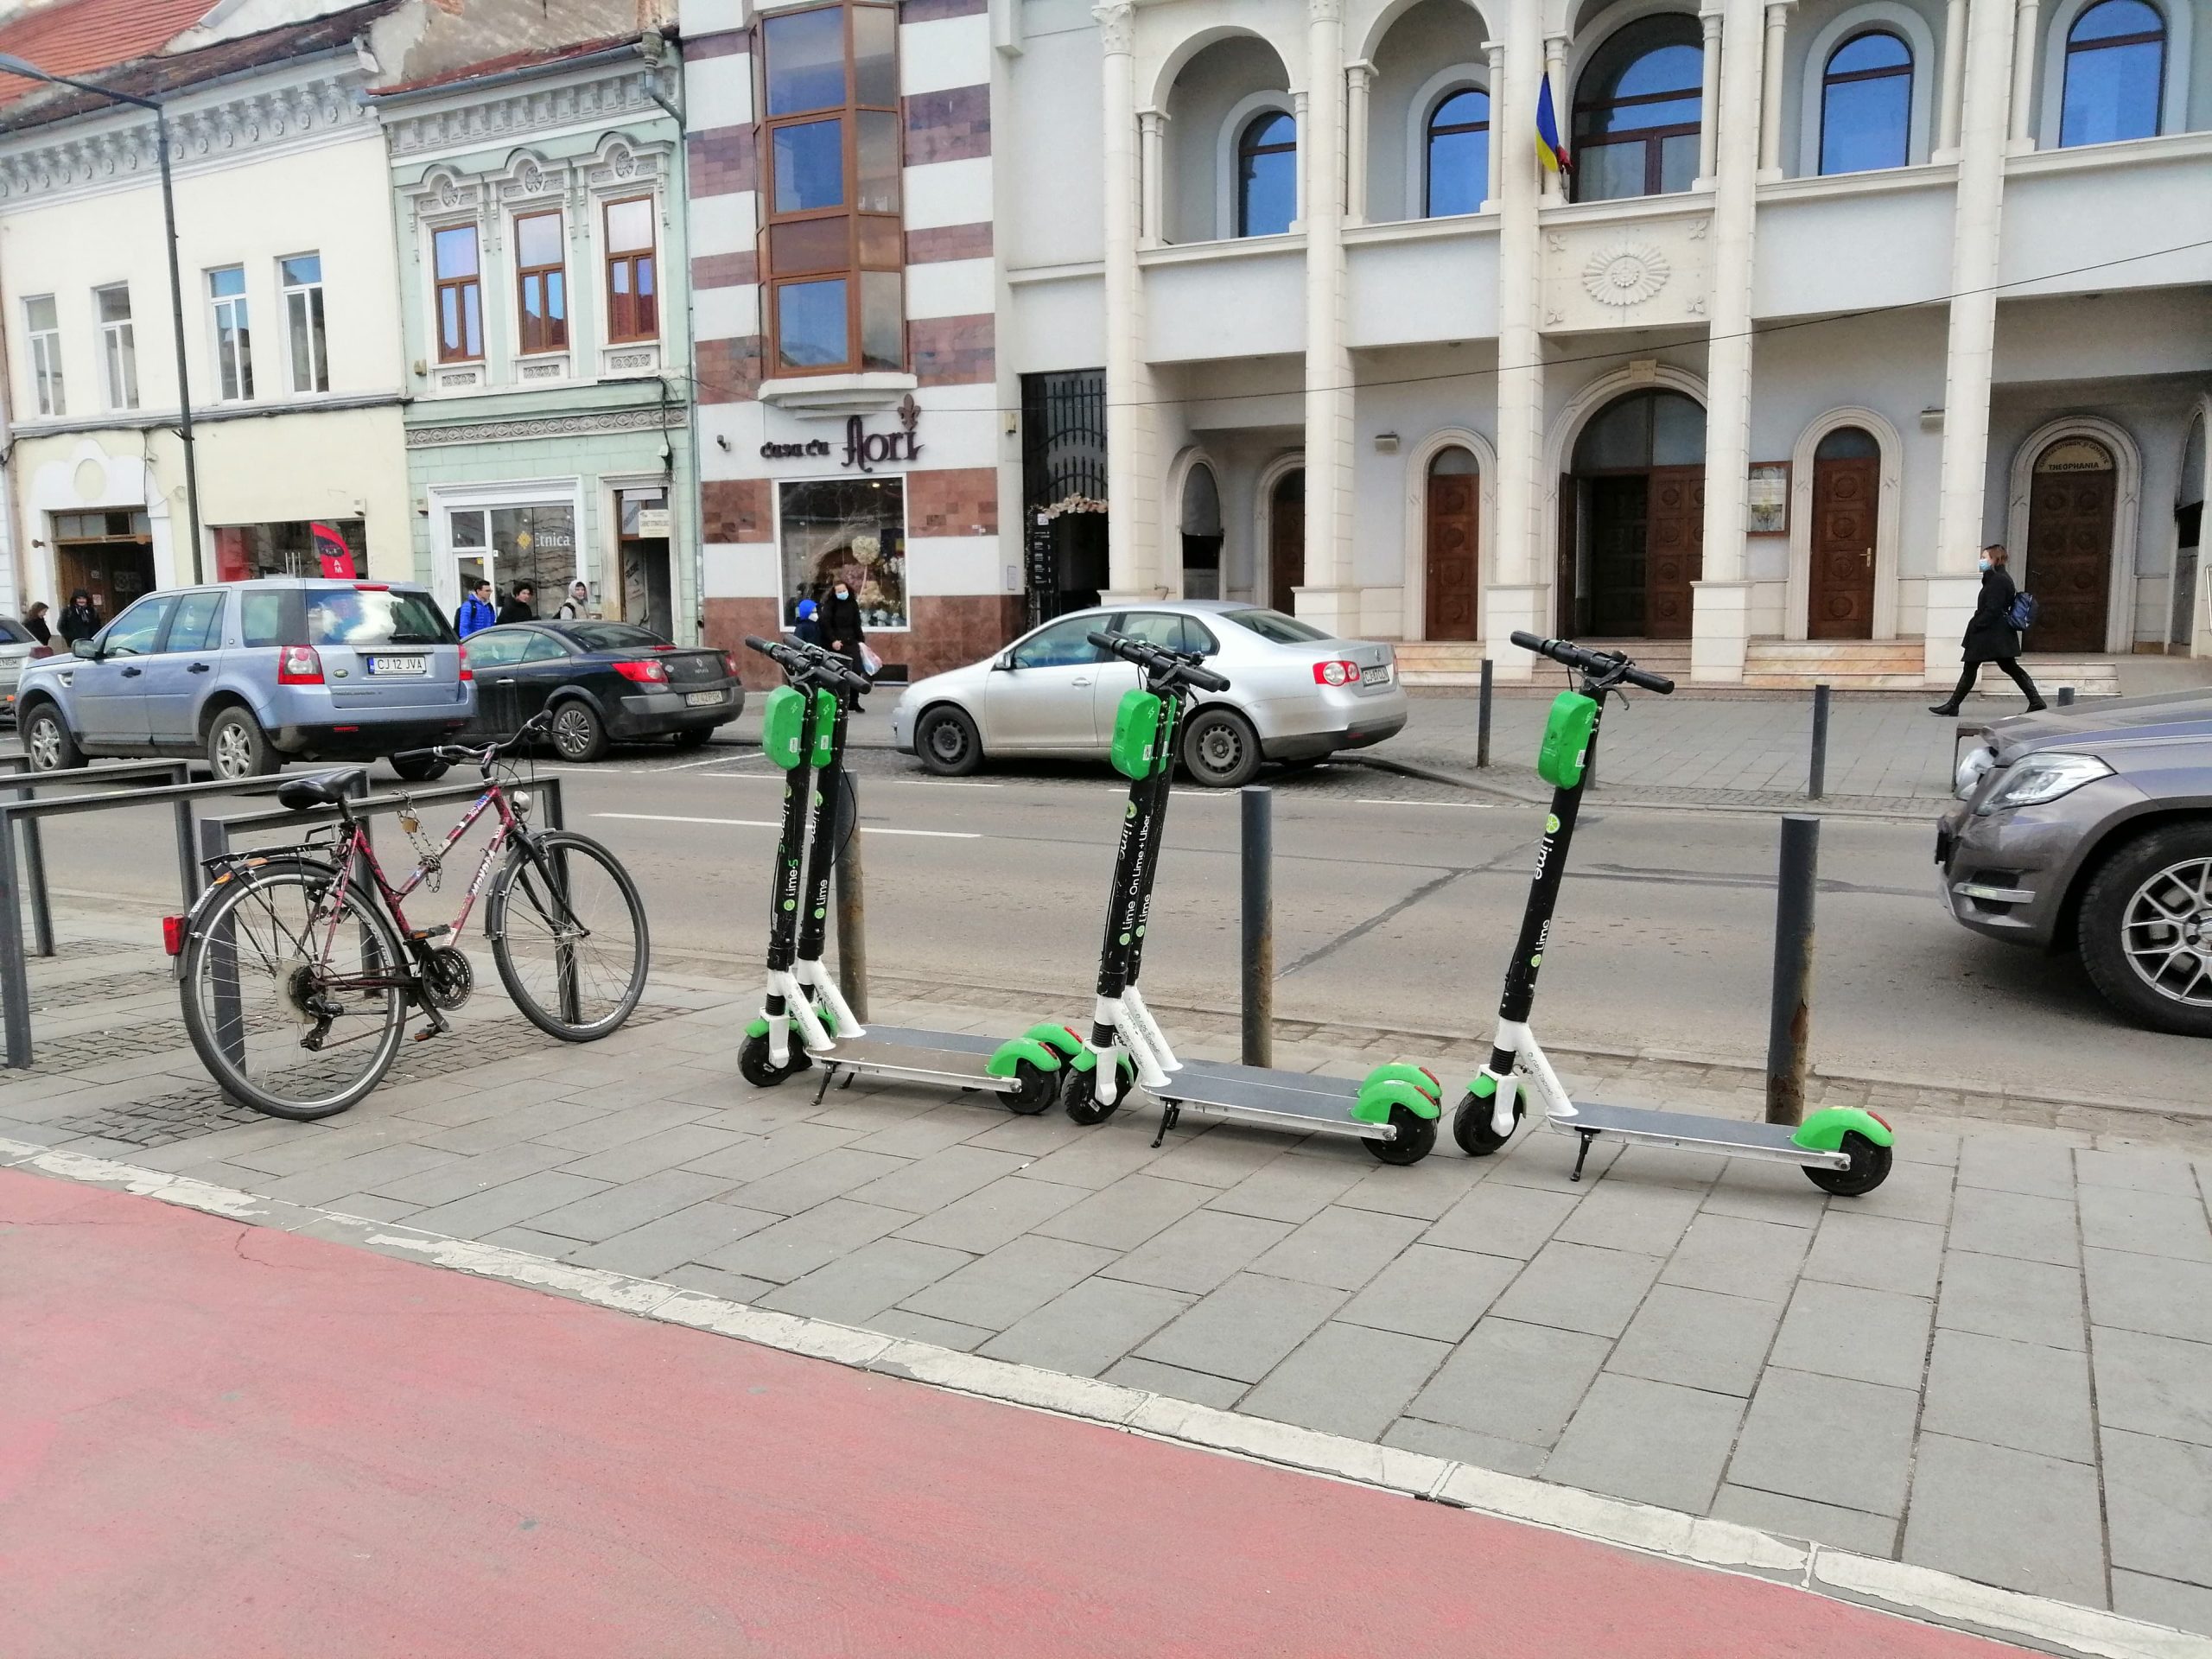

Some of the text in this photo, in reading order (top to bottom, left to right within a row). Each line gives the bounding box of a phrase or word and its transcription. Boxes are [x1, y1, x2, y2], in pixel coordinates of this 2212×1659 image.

[2049, 461, 2100, 471] THEOPHANIA
[534, 532, 571, 547] Etnica
[377, 658, 423, 670] CJ 12 JVA
[1138, 814, 1151, 842] Uber
[1132, 850, 1145, 877] Lime
[1534, 836, 1554, 880] Lime
[816, 879, 829, 906] Lime
[1128, 878, 1140, 896] On
[1122, 900, 1136, 931] Lime
[1139, 893, 1151, 923] Lime
